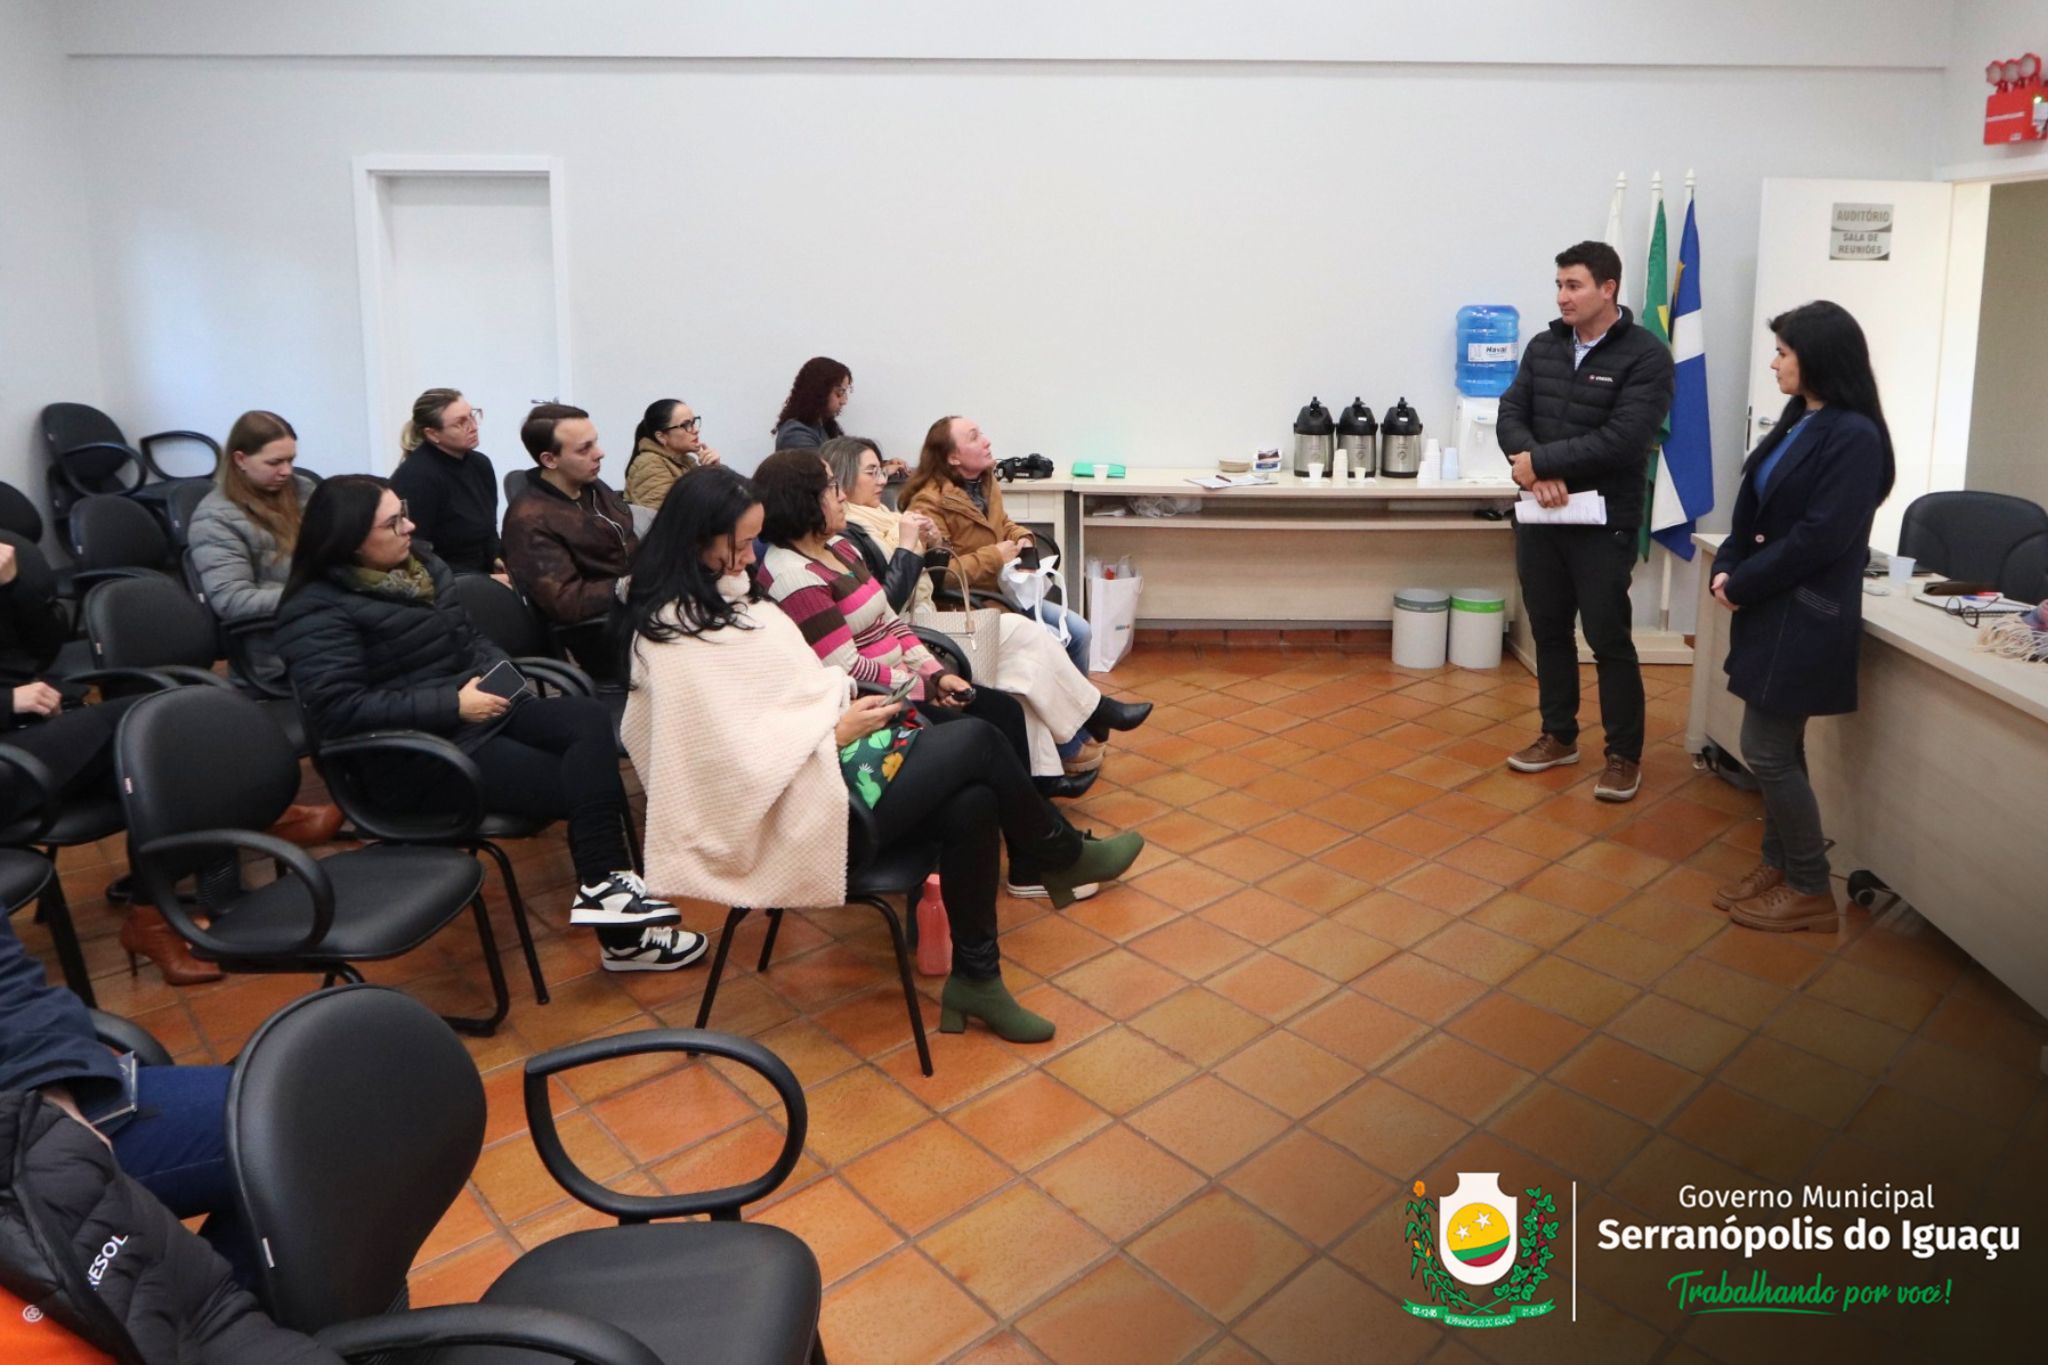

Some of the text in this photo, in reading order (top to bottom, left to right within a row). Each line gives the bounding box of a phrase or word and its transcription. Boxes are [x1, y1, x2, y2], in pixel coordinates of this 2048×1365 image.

[1837, 209, 1890, 222] AUDITÓRIO
[1843, 232, 1879, 242] SALA DE
[1838, 244, 1882, 254] REUNIÕES
